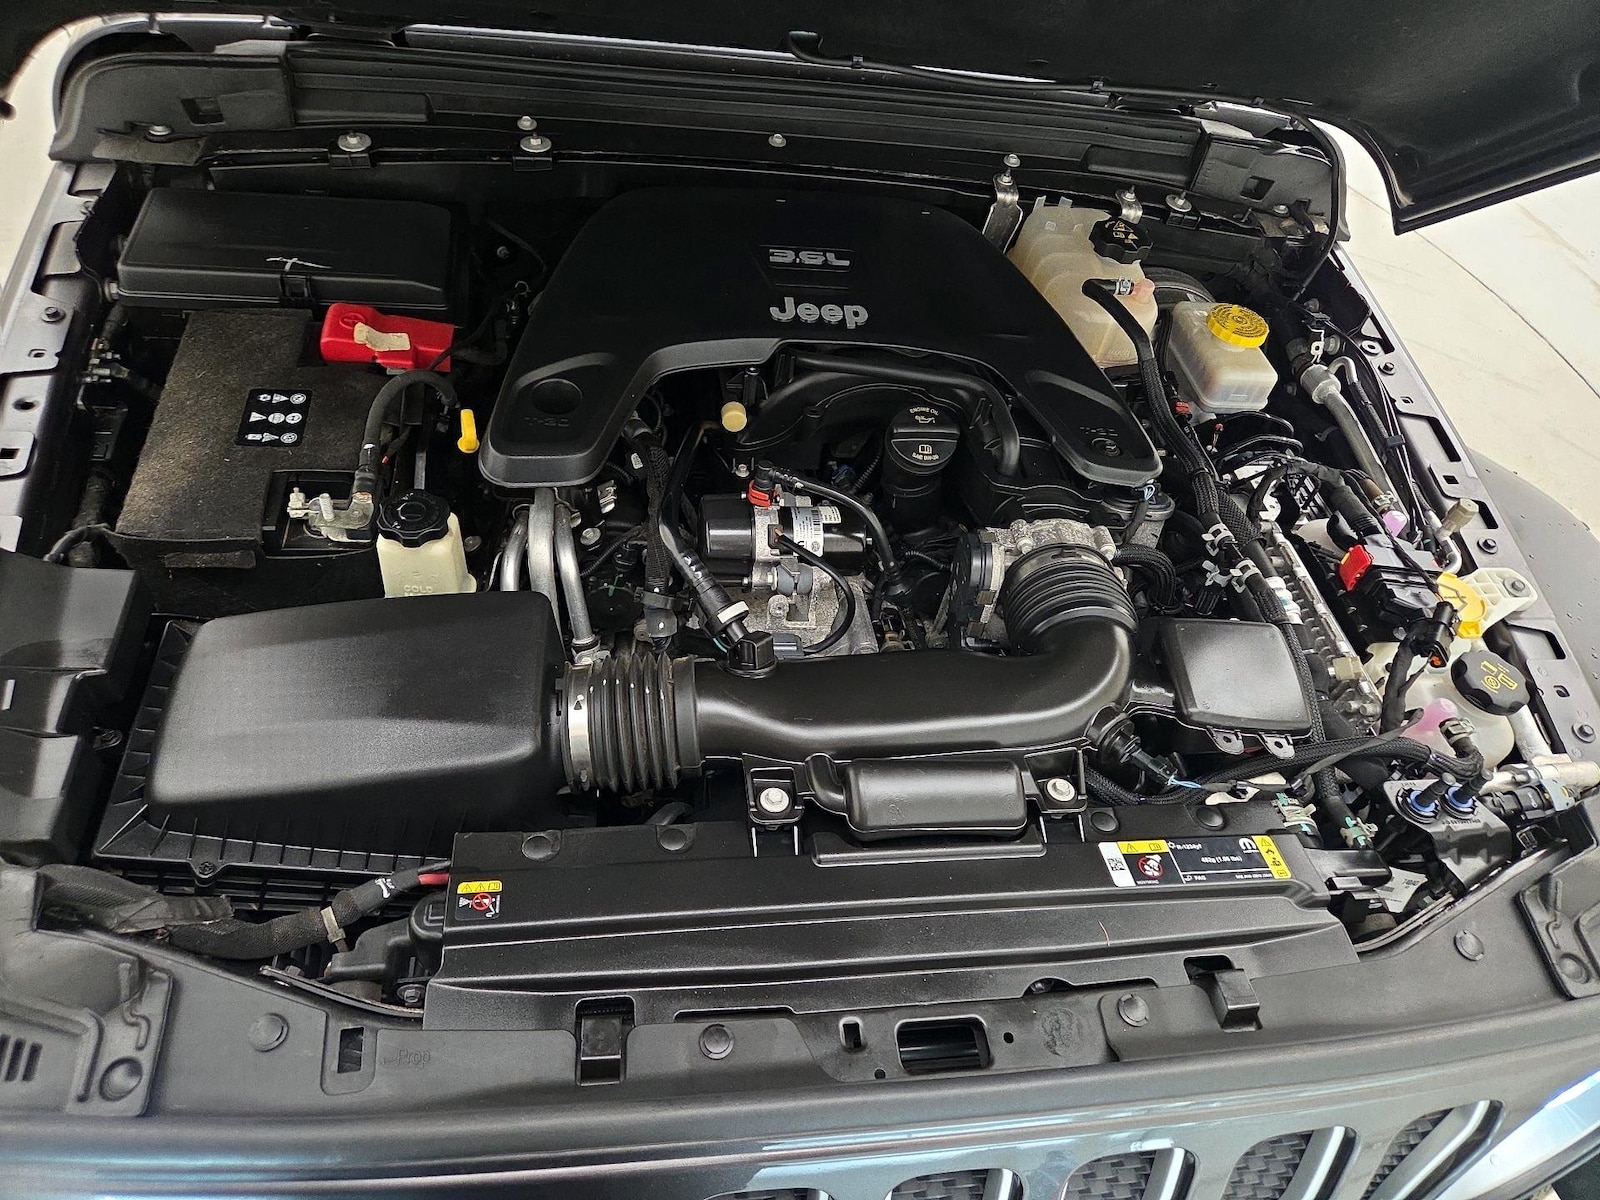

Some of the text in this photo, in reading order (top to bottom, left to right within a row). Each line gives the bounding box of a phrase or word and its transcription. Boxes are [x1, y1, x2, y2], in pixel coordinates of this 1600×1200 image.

[769, 249, 850, 266] 3.6L
[769, 296, 868, 329] Jeep
[403, 584, 433, 594] COLD
[398, 1049, 430, 1068] Prop
